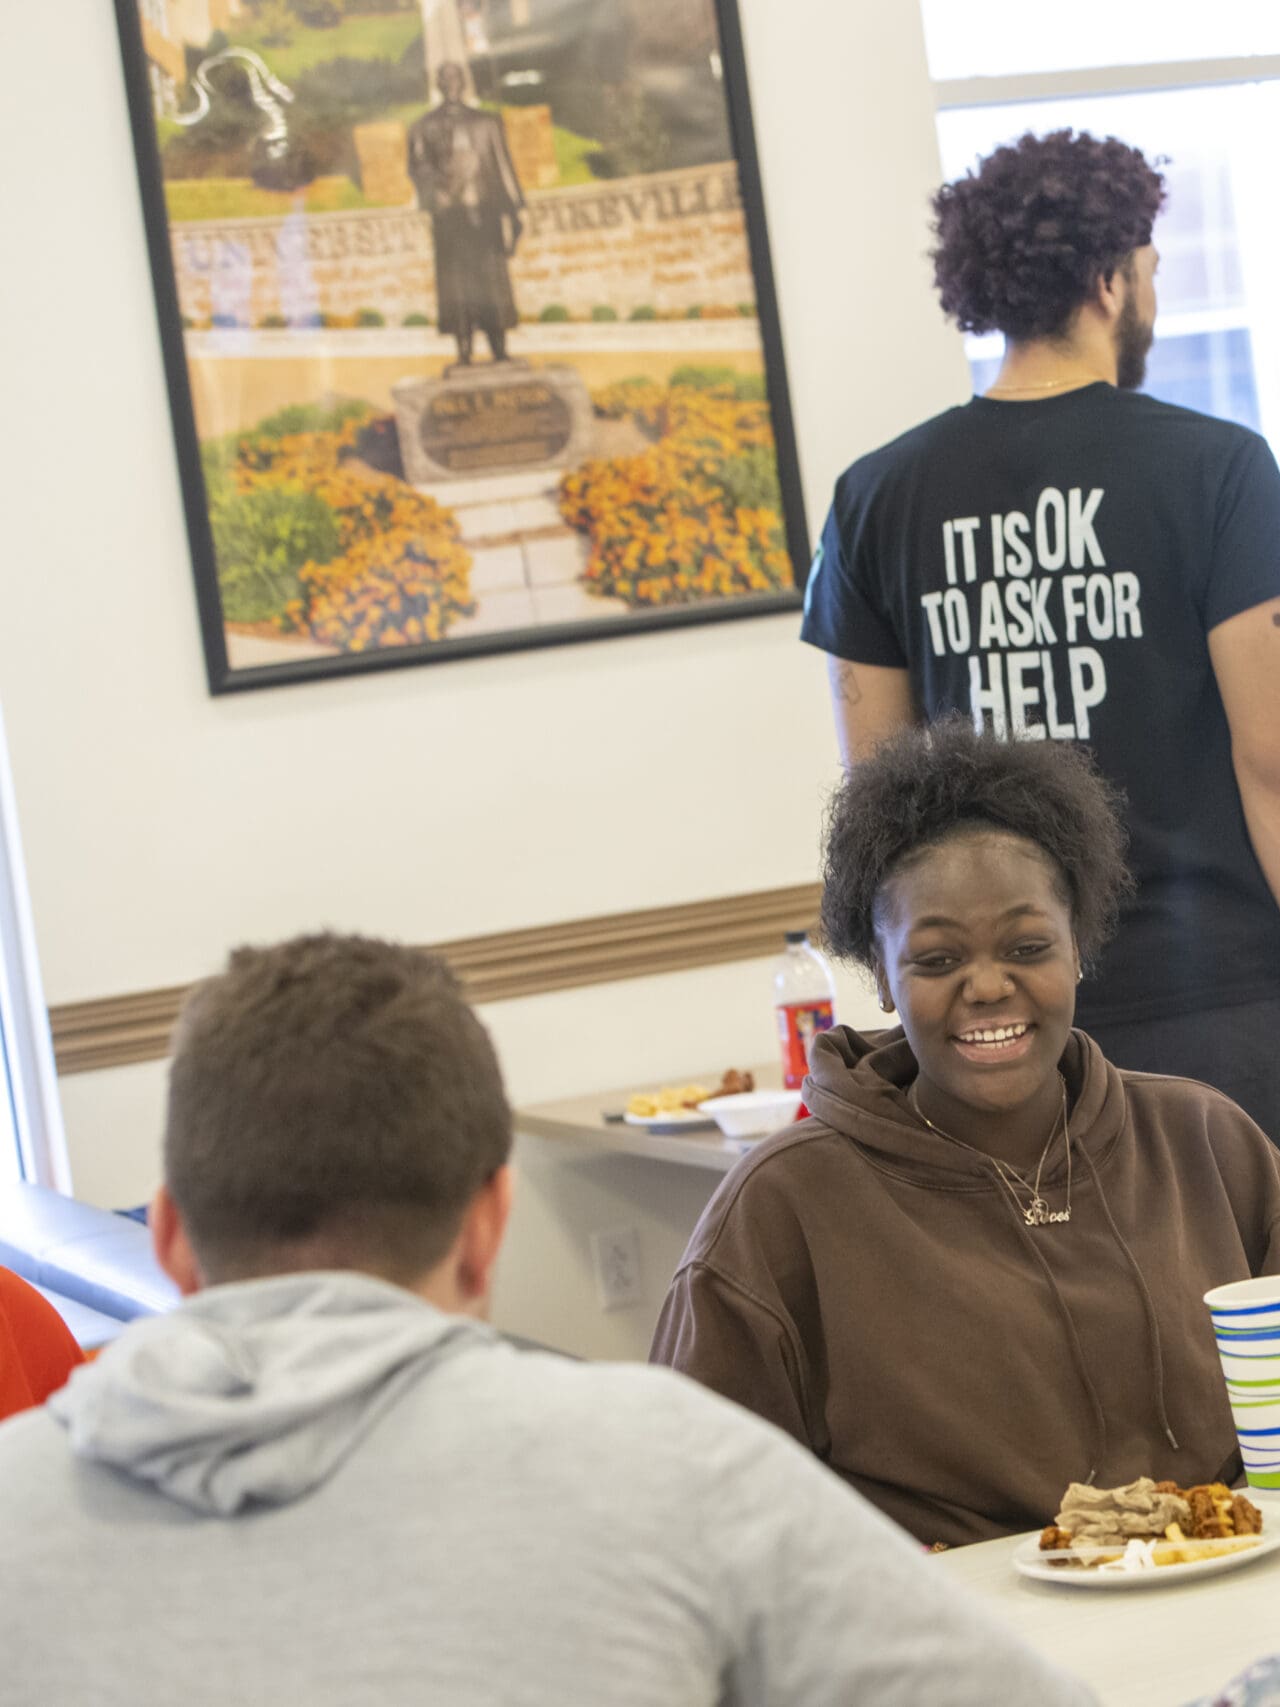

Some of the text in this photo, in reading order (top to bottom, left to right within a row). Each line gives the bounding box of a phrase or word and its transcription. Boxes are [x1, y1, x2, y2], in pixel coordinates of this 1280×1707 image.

[943, 487, 1106, 585] IT IS OK
[921, 571, 1143, 656] TO ASK FOR
[968, 646, 1107, 743] HELP
